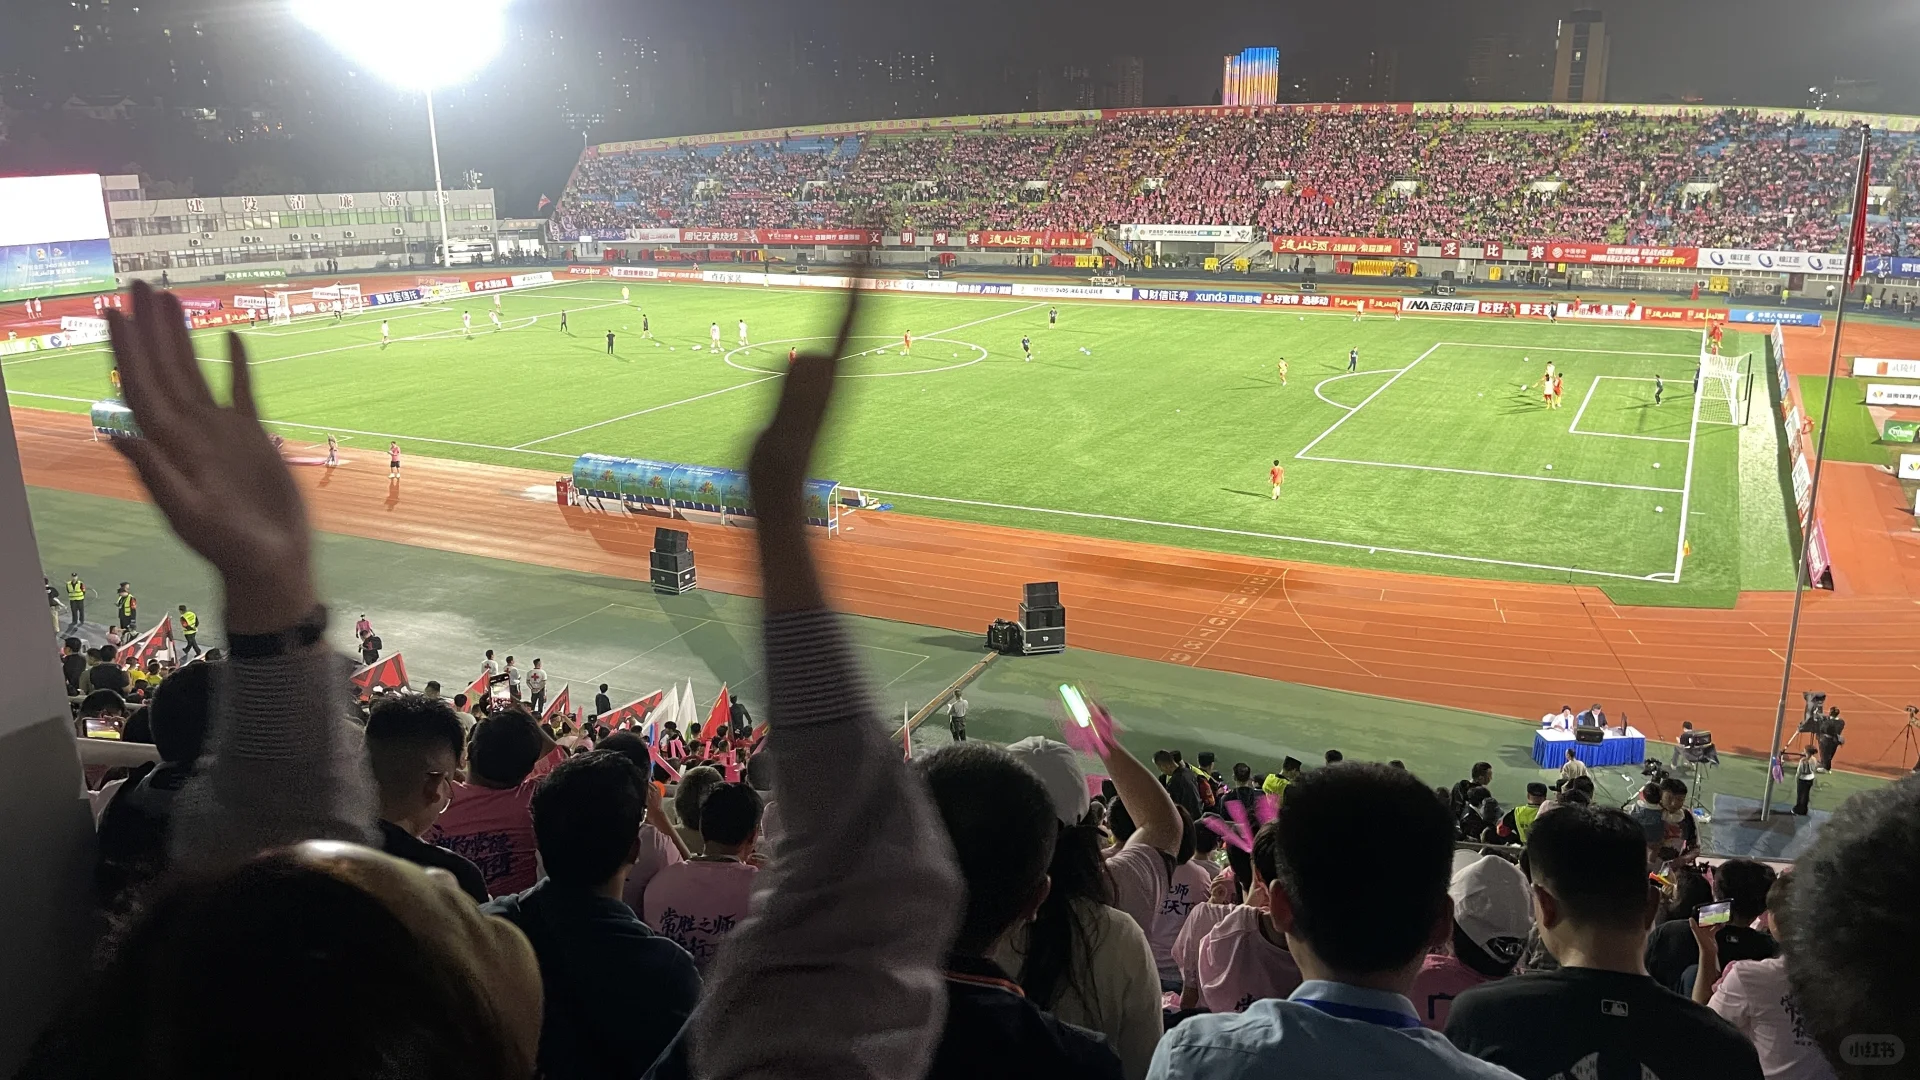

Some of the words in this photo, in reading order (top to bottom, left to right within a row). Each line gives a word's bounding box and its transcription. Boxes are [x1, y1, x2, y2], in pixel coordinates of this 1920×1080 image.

[1402, 240, 1544, 260] 享受比赛
[1149, 290, 1188, 301] 财信证券
[1196, 292, 1228, 302] xunda
[1230, 597, 1249, 605] 4
[1208, 617, 1229, 626] 6
[1199, 627, 1218, 637] 7
[1183, 640, 1204, 650] 8
[1169, 652, 1192, 662] 9
[660, 906, 737, 938] 常胜之师
